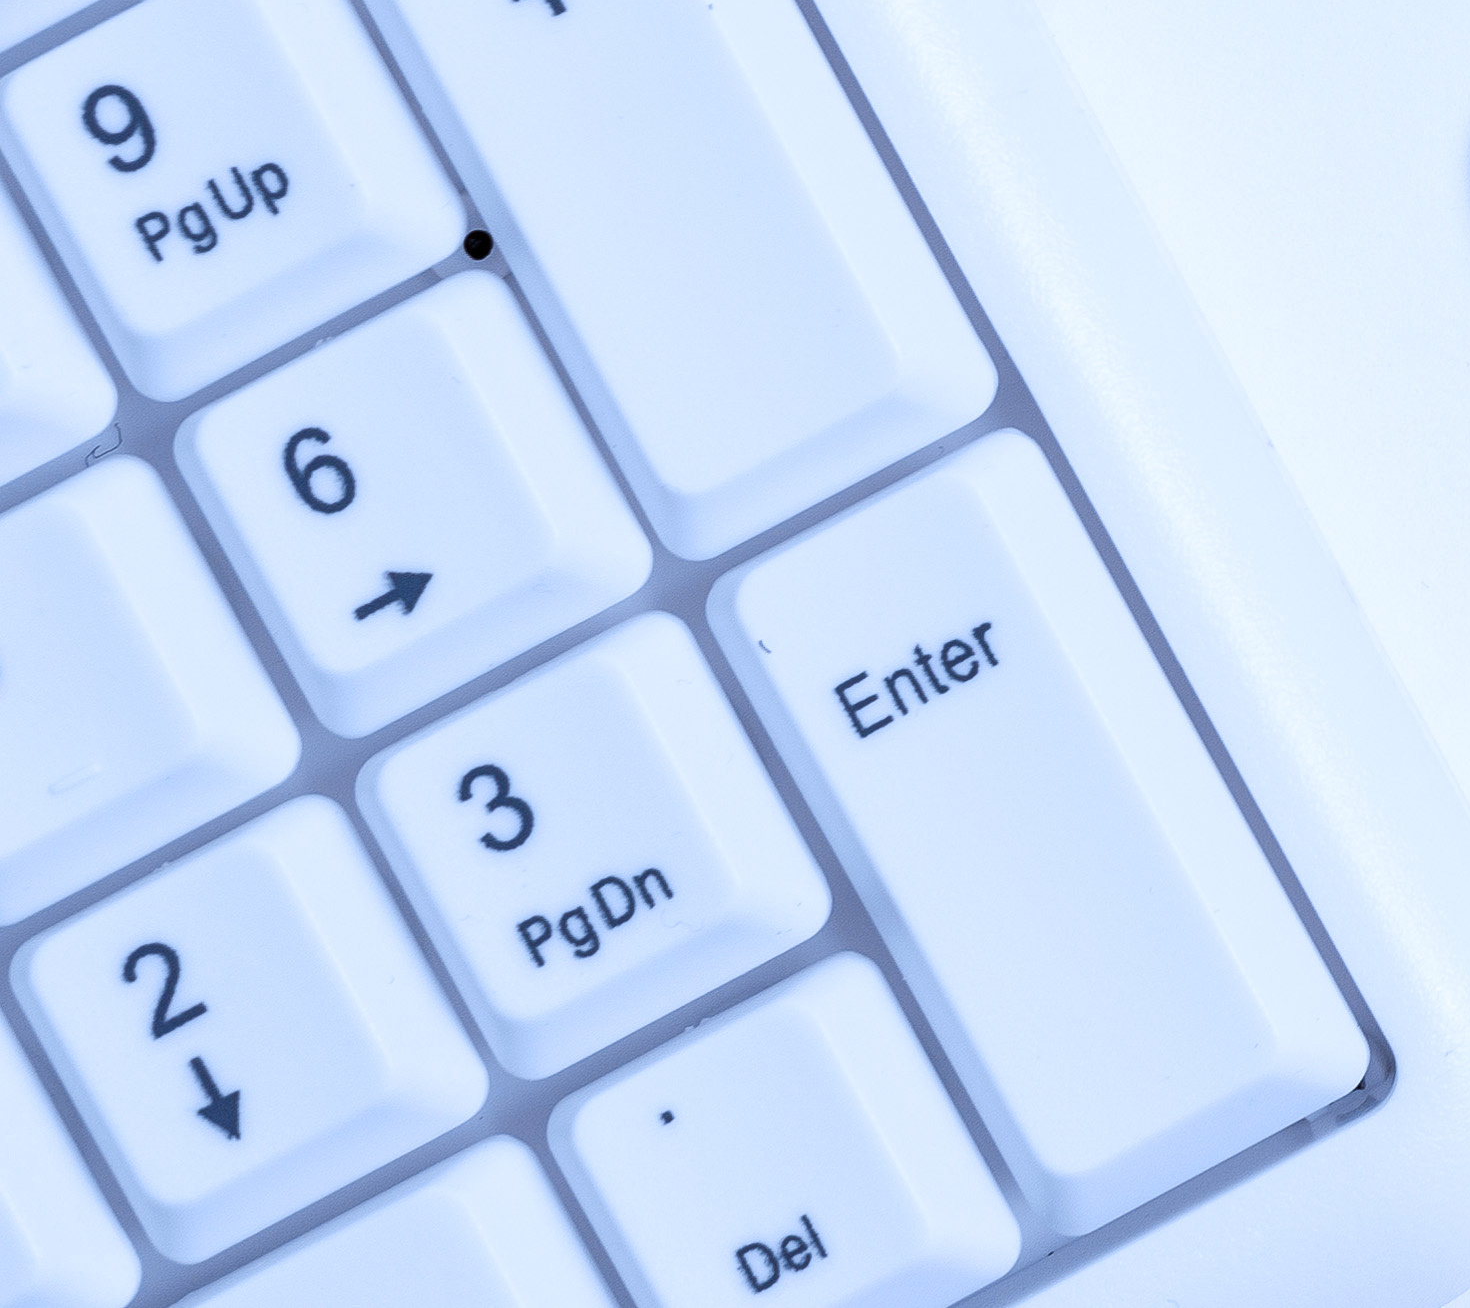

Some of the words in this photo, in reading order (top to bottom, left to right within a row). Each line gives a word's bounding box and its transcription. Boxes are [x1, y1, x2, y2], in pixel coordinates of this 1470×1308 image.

[80, 83, 158, 175] 9
[135, 153, 290, 264] PgUp
[281, 425, 358, 516] 6
[832, 621, 1002, 740] Enter
[456, 762, 536, 853] 3
[517, 858, 675, 969] PgDn
[120, 940, 209, 1041] 2
[734, 1212, 829, 1295] Del
